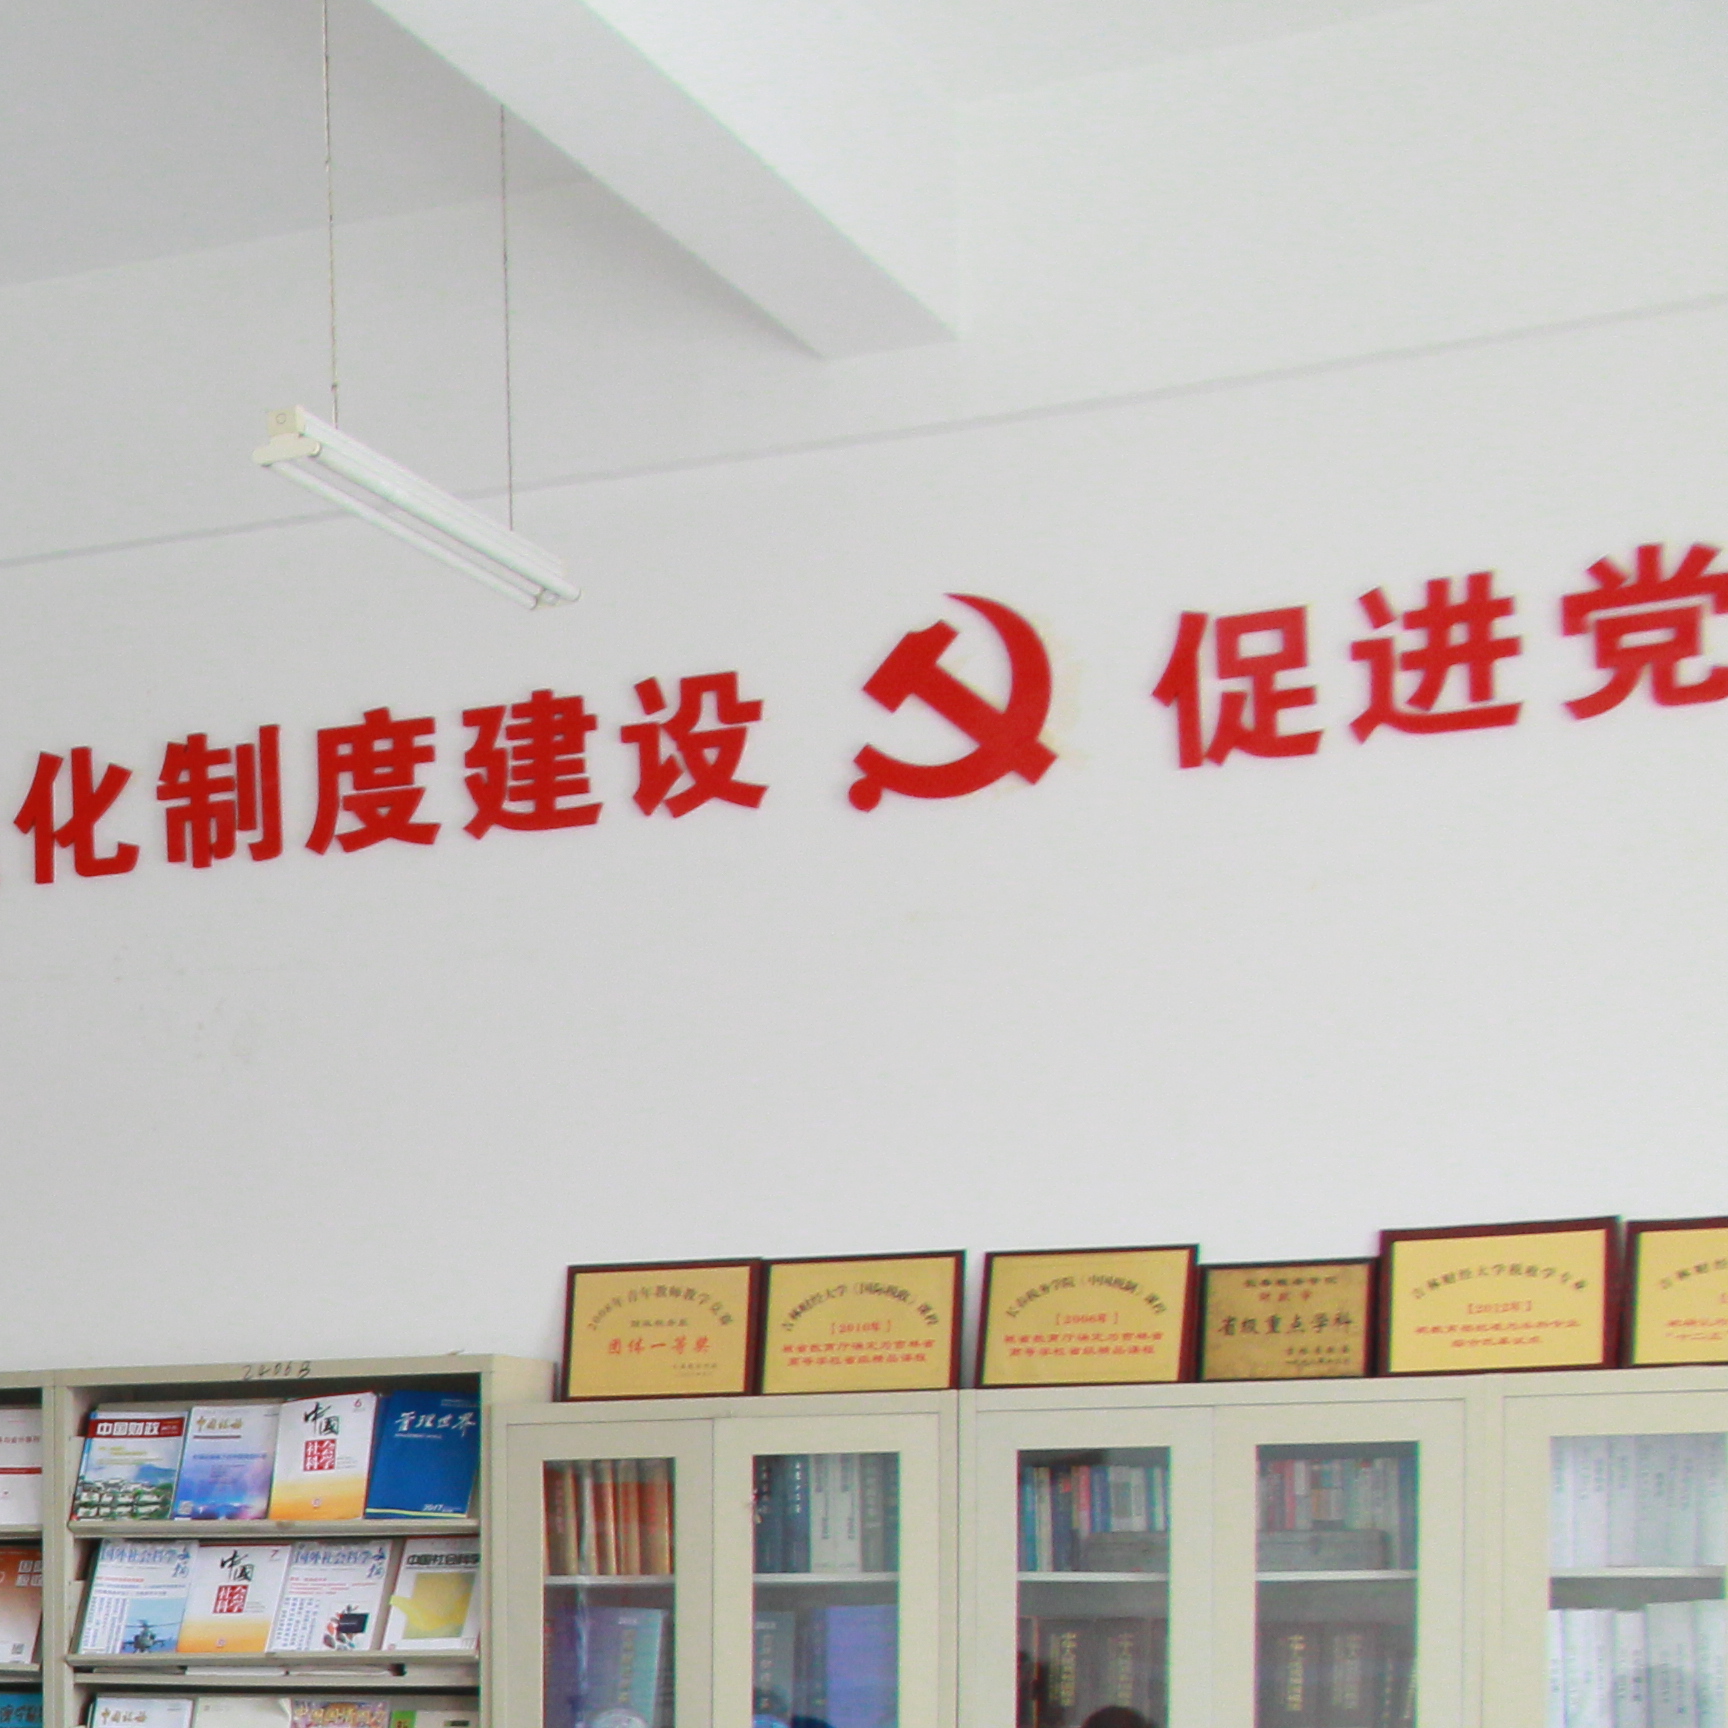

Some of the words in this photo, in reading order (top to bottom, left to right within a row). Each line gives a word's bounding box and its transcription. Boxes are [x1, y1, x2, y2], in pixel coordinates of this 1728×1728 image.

[1151, 541, 1728, 771] 促进党
[96, 1421, 161, 1436] 中国财政
[304, 1401, 340, 1435] 中国
[395, 1411, 477, 1438] 管理世界
[220, 1549, 255, 1582] 中国
